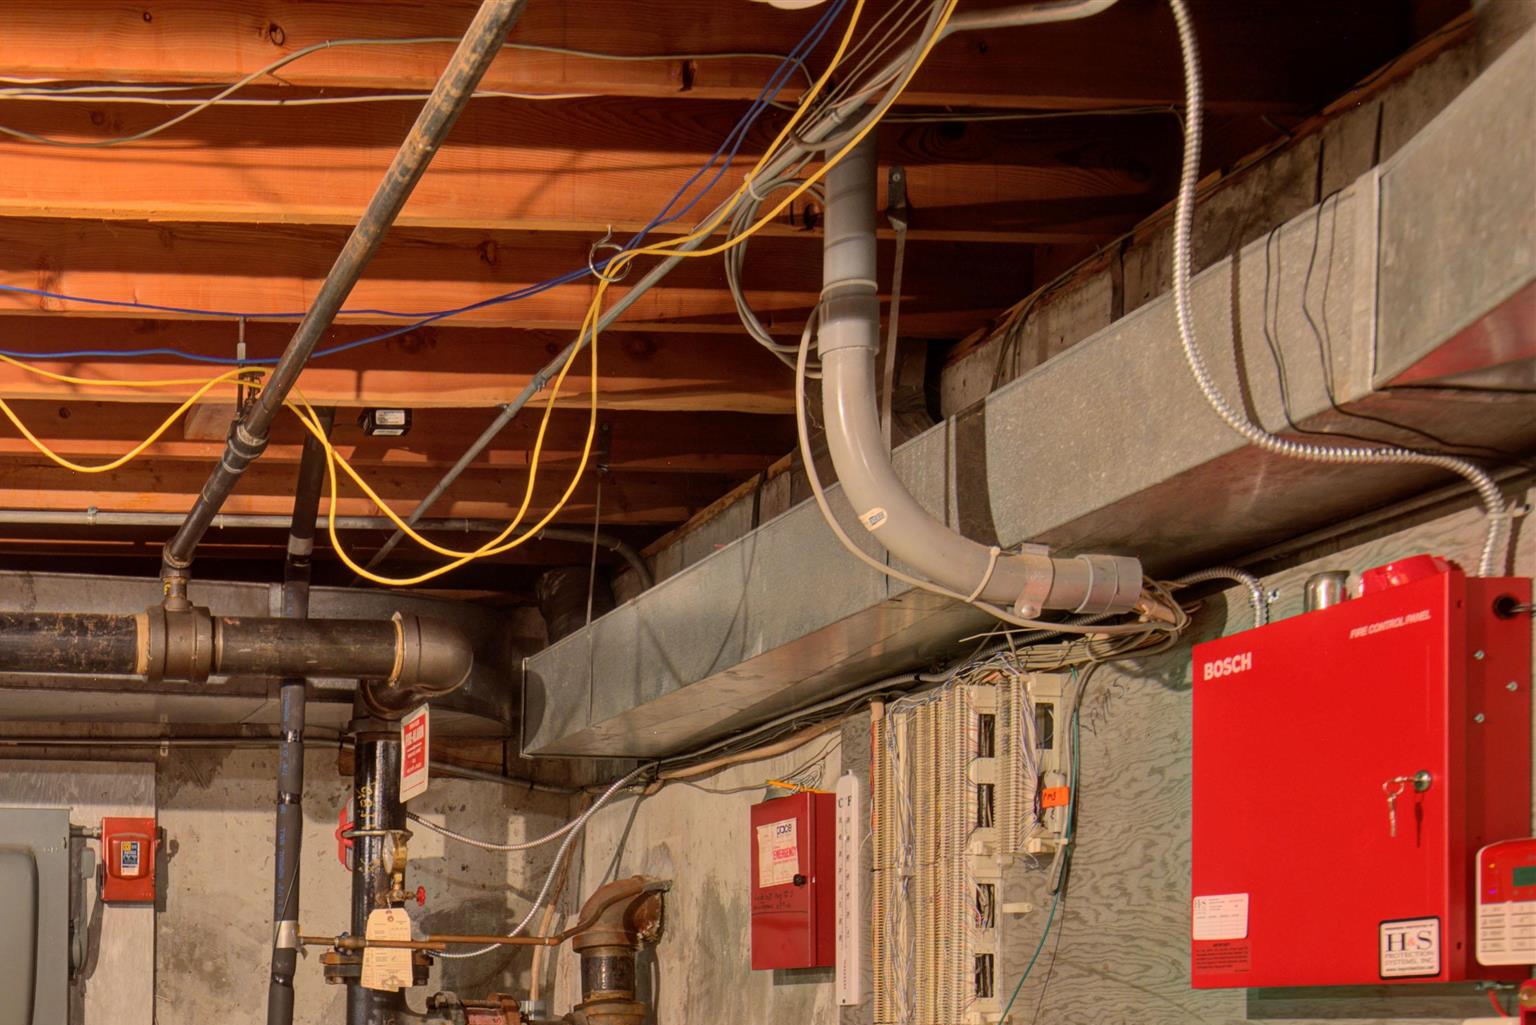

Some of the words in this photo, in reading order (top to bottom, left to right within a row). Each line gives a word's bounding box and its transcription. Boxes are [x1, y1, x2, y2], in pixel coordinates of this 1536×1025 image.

[1349, 625, 1368, 640] FIRE
[1368, 616, 1406, 634] CONTROL
[1405, 609, 1431, 624] PANEL
[1203, 651, 1252, 681] BOSCH
